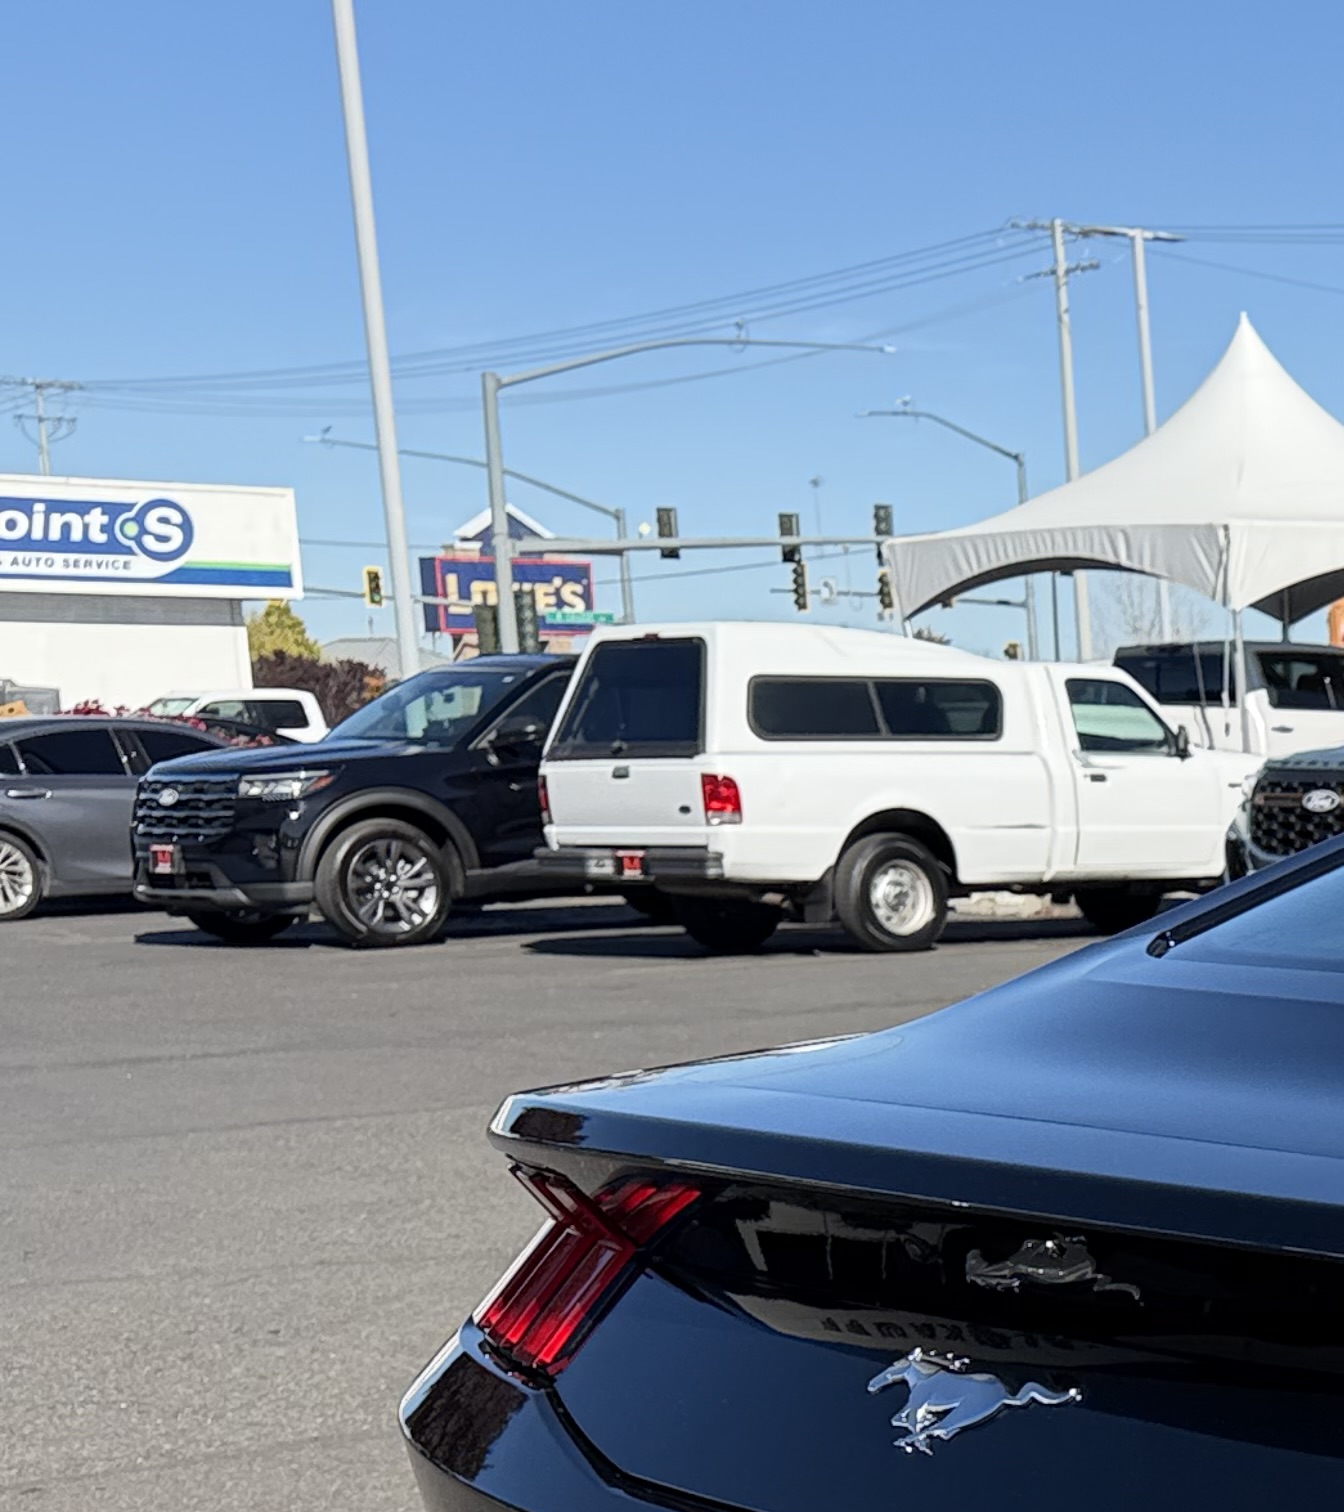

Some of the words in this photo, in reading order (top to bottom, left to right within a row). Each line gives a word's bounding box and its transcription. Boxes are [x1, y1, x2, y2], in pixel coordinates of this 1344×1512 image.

[141, 506, 184, 553] S
[10, 556, 55, 568] AUTO
[62, 558, 132, 571] SERVICE
